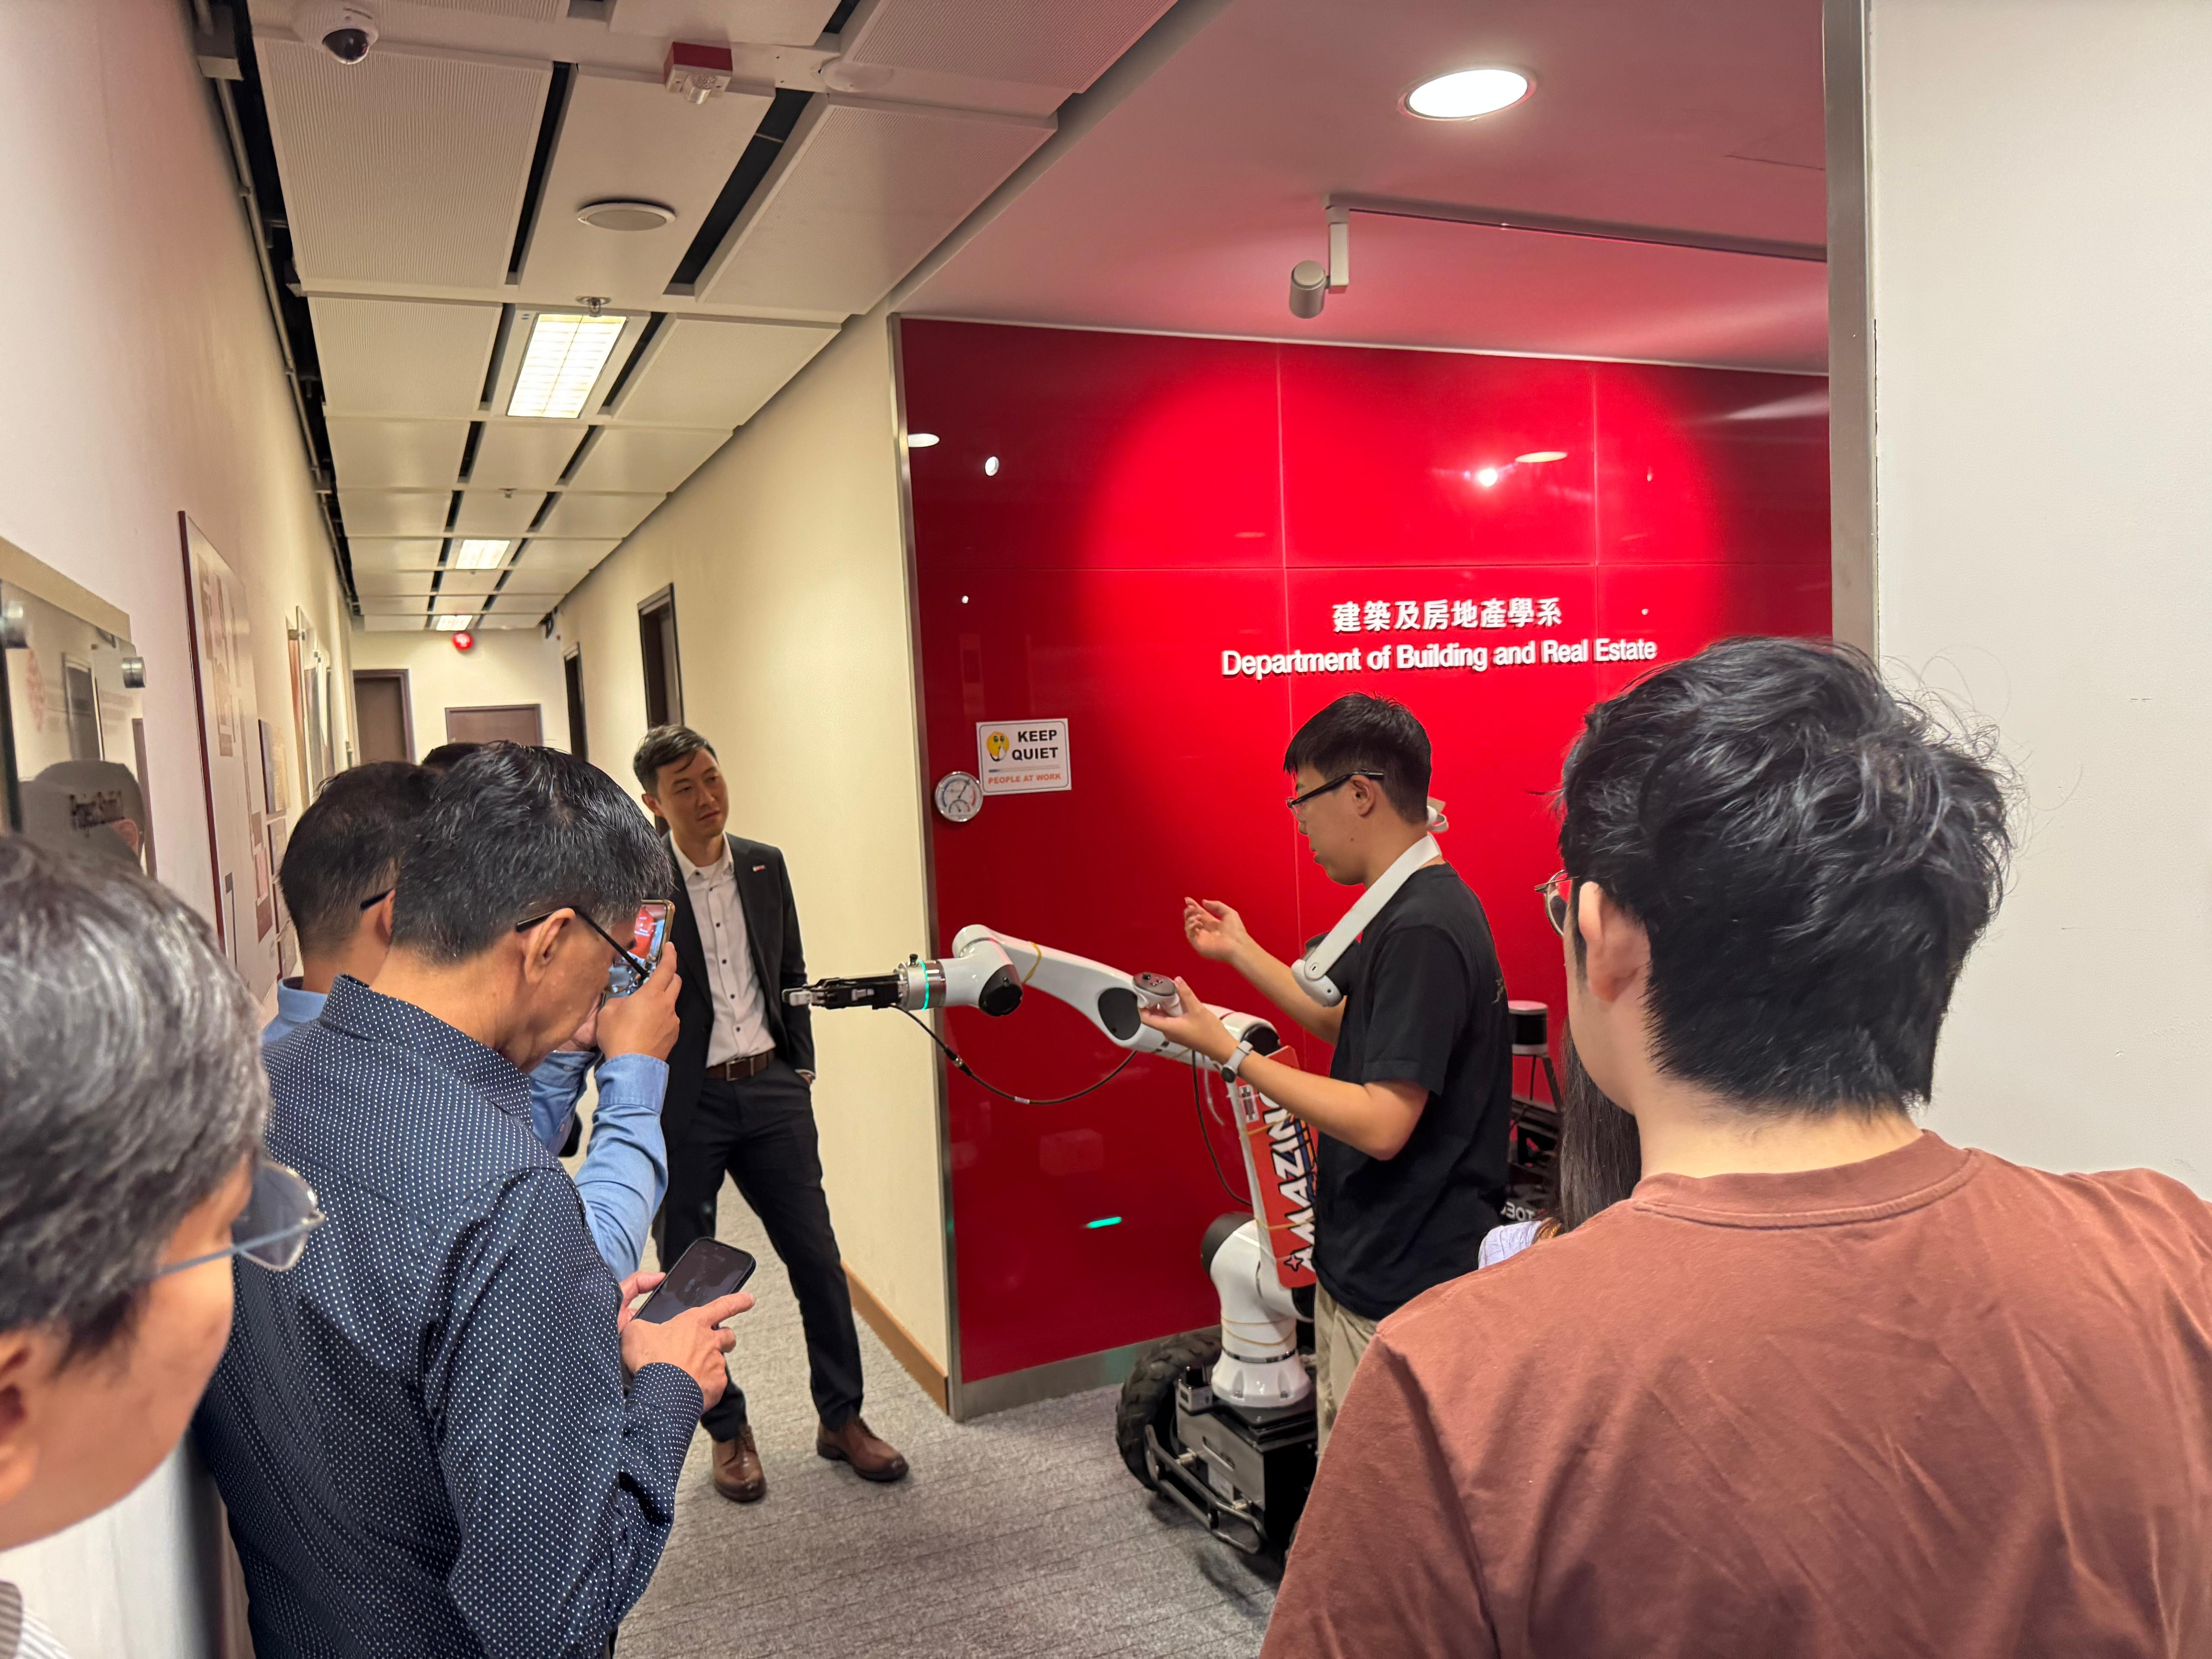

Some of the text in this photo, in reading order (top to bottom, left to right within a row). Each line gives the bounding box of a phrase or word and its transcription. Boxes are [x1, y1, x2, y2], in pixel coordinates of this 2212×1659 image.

[1332, 597, 1563, 632] 建築及房地產學系
[1221, 638, 1657, 680] Department of Building and Real Estate
[1018, 729, 1058, 743] KEEP
[1012, 747, 1058, 761] QUIET
[988, 775, 1020, 785] PEOPLE
[1036, 773, 1062, 782] WORK
